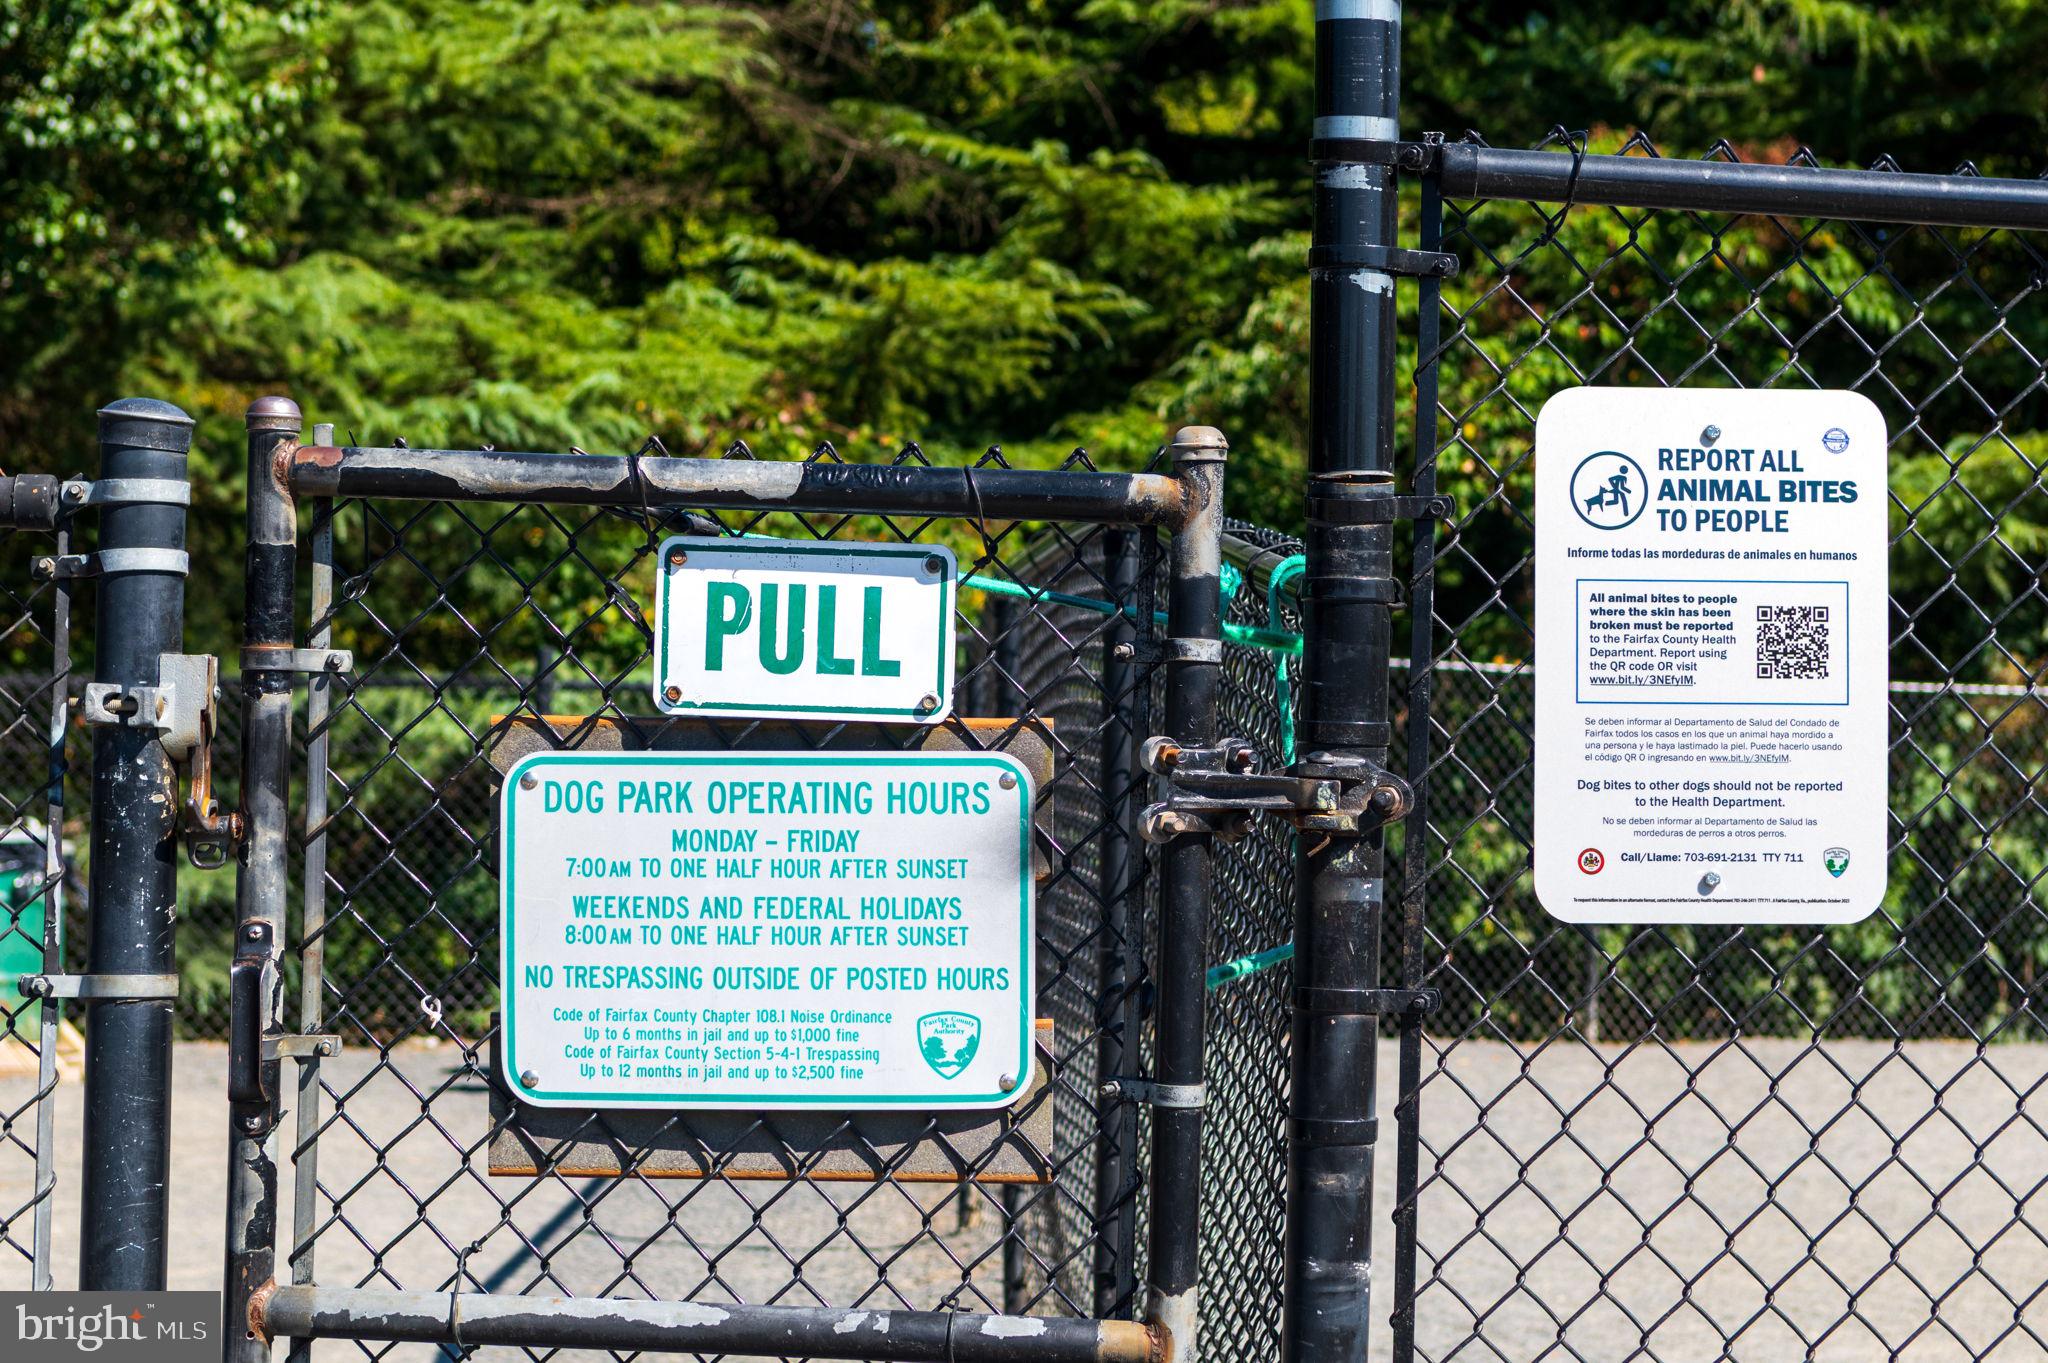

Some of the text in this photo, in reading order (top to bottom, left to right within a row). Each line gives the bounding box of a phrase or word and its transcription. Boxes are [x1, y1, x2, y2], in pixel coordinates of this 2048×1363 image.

[1659, 449, 1804, 472] REPORT ALL
[1658, 479, 1858, 503] ANIMAL BITES
[1657, 509, 1788, 532] TO PEOPLE
[1568, 547, 1857, 560] Informe todas las mordeduras de animales en humanos
[1590, 593, 1737, 605] All animal bites to people
[1590, 607, 1730, 617] where the skin has been
[705, 582, 900, 677] PULL
[1590, 620, 1733, 632] broken must be reported
[1590, 634, 1736, 646] to the Fairfax County Health
[1590, 648, 1727, 660] Department. Report using
[1590, 661, 1697, 672] the QR code OR visit
[1578, 780, 1842, 792] Dog bites to other dogs should not be reported
[544, 780, 990, 814] DOG PARK OPERATING HOURS
[1635, 796, 1784, 808] to the Health Department.
[1658, 817, 1692, 825] informar
[1705, 818, 1764, 826] Departamento
[1806, 818, 1817, 826] las
[672, 829, 860, 852] MONDAY FRIDAY
[1621, 853, 1803, 863] Call/Llame: 703-691-2131 TTY 711
[640, 858, 661, 878] TO
[670, 858, 706, 878] ONE
[717, 859, 762, 878] HALF
[771, 859, 820, 878] HOUR
[830, 859, 887, 878] AFTER
[897, 859, 968, 879] SUNSET
[573, 896, 962, 920] WEEKENDS AND FEDERAL HOLIDAYS
[640, 925, 661, 944] TO
[671, 925, 707, 945] ONE
[718, 926, 762, 945] HALF
[772, 926, 821, 946] HOUR
[830, 926, 887, 946] AFTER
[898, 926, 968, 946] SUNSET
[526, 965, 1009, 990] NO TRESPASSING OUTSIDE OF POSTED HOURS
[554, 1008, 892, 1025] Code of Fairfax County Chapter 108.1 Noise Ordinance
[584, 1027, 859, 1044] Up to 6 months in jail and up to $1,000 fine
[565, 1044, 879, 1064] Code of Fairfax County Section 5-4-1 Trespassing
[580, 1064, 863, 1082] Up to 12 months in jail and up to $2,500 fine
